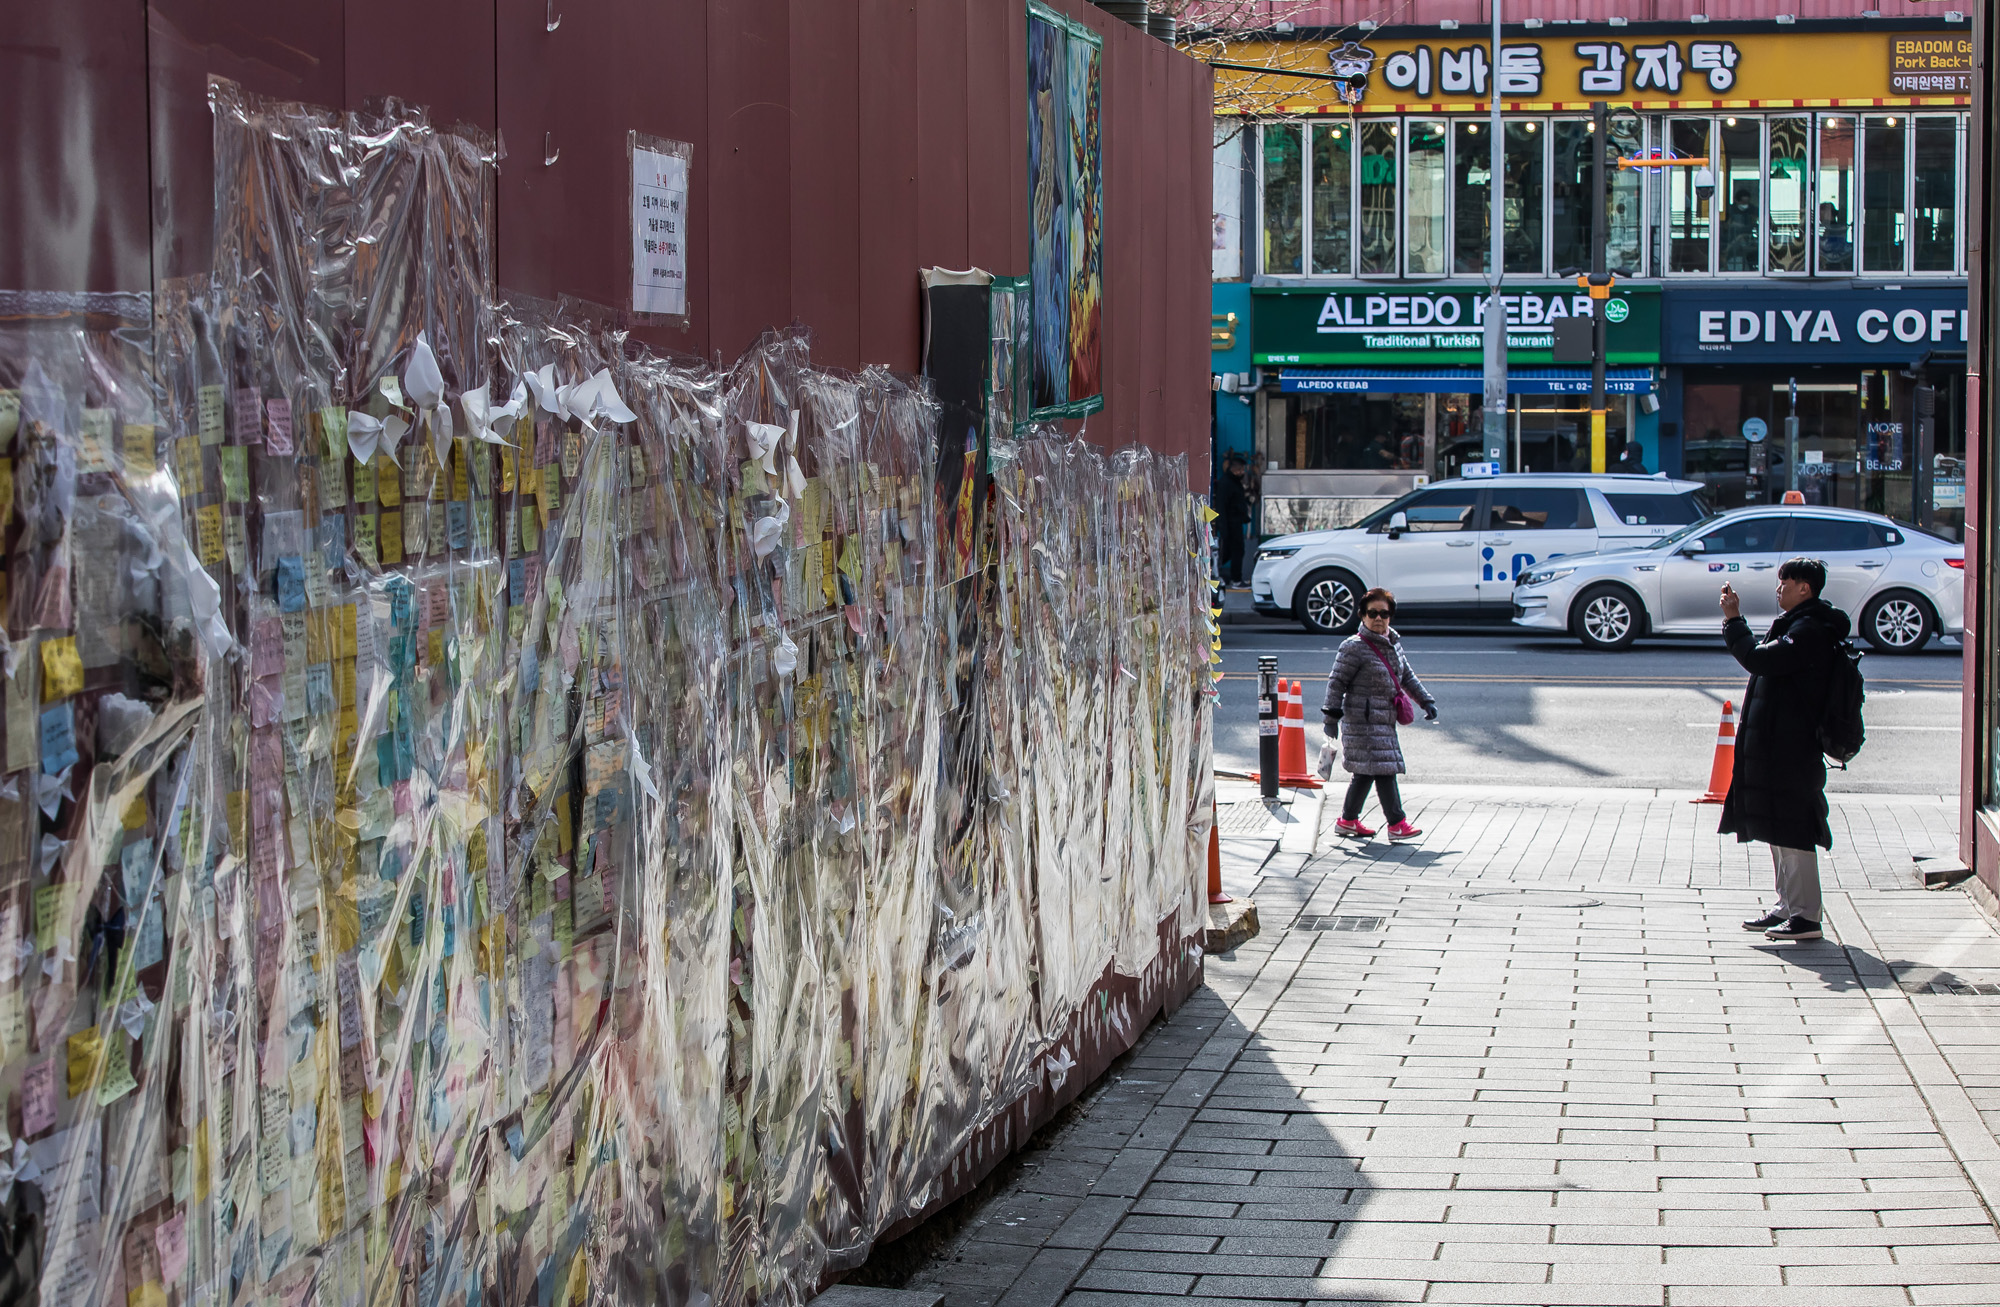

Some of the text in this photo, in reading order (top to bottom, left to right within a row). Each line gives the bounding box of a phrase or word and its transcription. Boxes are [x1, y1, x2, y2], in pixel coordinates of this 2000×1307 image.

[1895, 40, 1953, 54] EBADOM
[1575, 41, 1741, 94] 감자탕
[1895, 55, 1926, 69] Pork
[1893, 76, 1971, 91] 이태원역점 T.
[1317, 295, 1461, 325] ALPEDO
[1699, 308, 1968, 343] EDIYA COF
[1363, 334, 1431, 348] Traditional
[1435, 334, 1480, 348] Turkish
[1297, 381, 1369, 389] ALPEDO KEBAB
[1548, 382, 1566, 390] TEL
[1868, 423, 1903, 434] MORE
